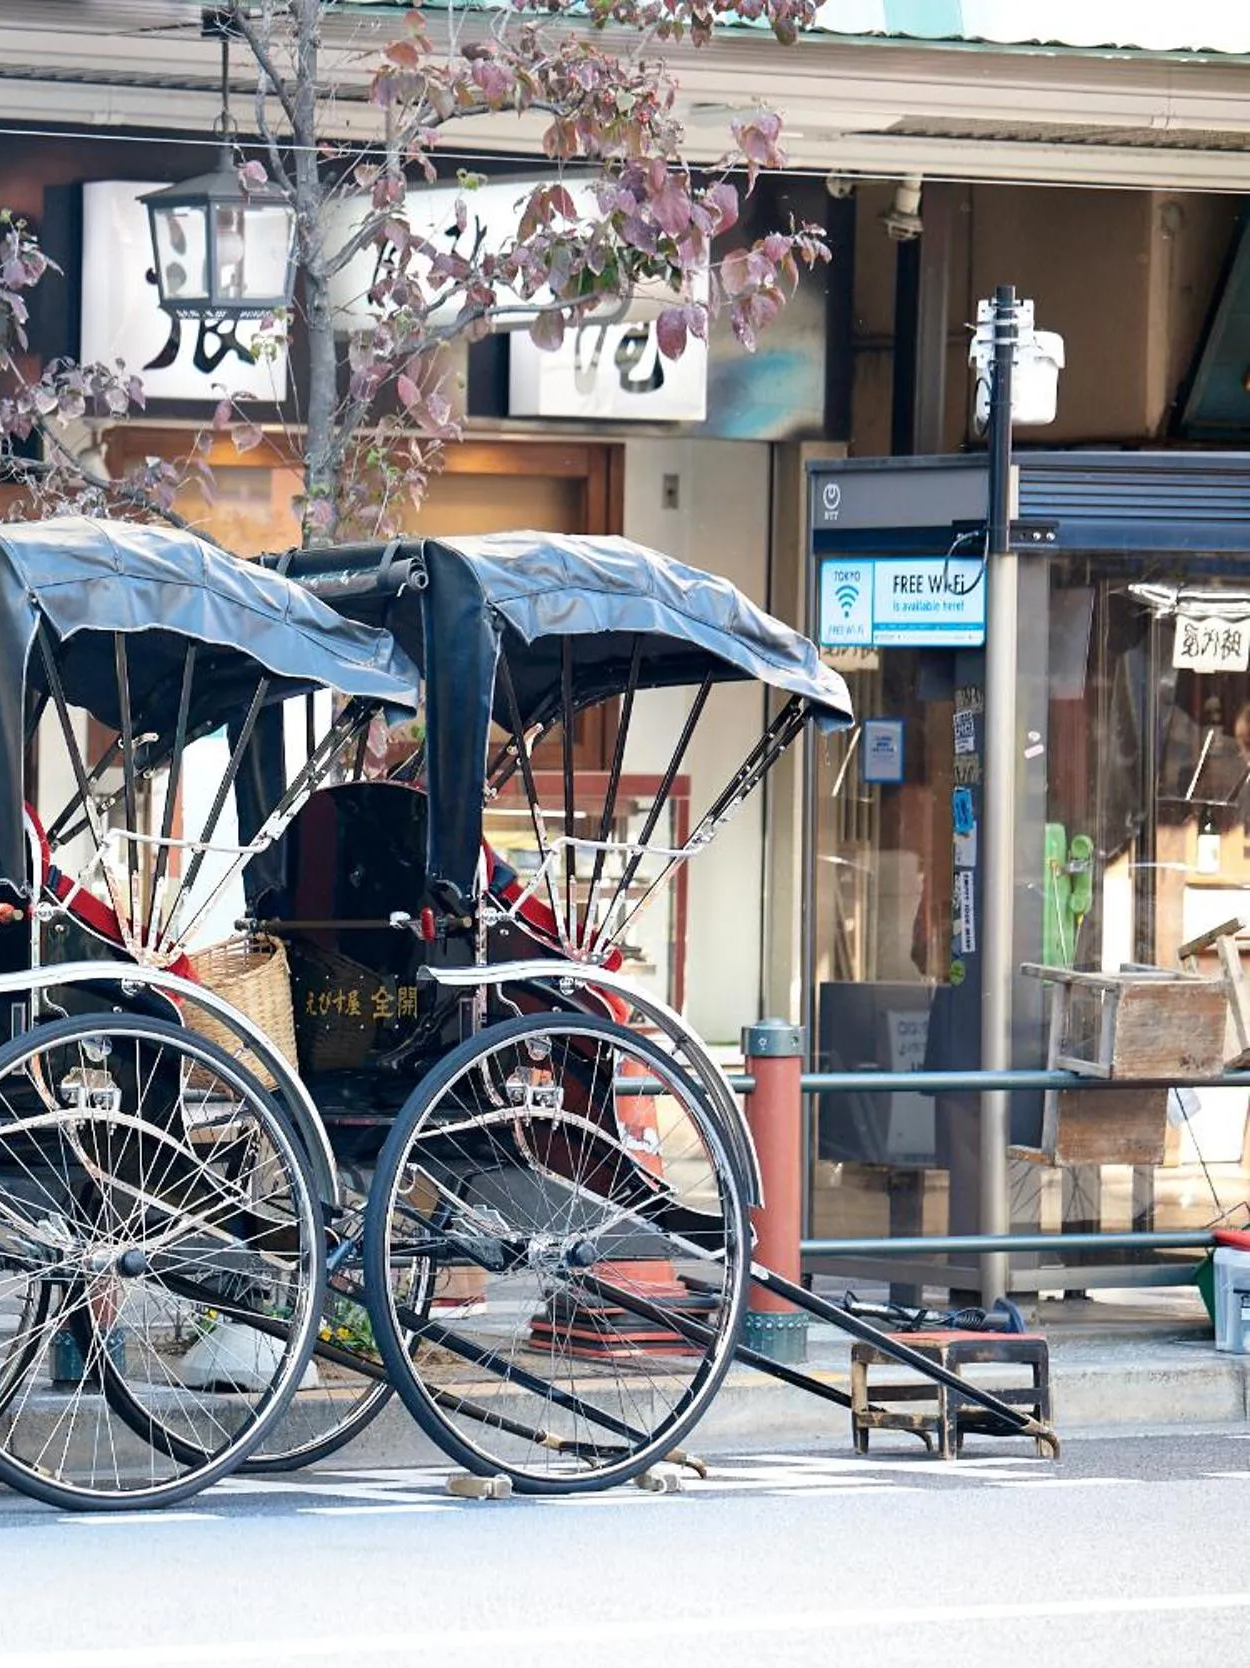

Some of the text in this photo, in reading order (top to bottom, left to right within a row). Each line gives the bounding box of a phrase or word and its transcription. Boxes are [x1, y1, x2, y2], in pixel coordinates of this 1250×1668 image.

[834, 570, 861, 583] TOKYO
[892, 574, 924, 594] FREE
[892, 599, 901, 612] is
[902, 600, 940, 612] available
[305, 985, 418, 1019] えびす屋 全開
